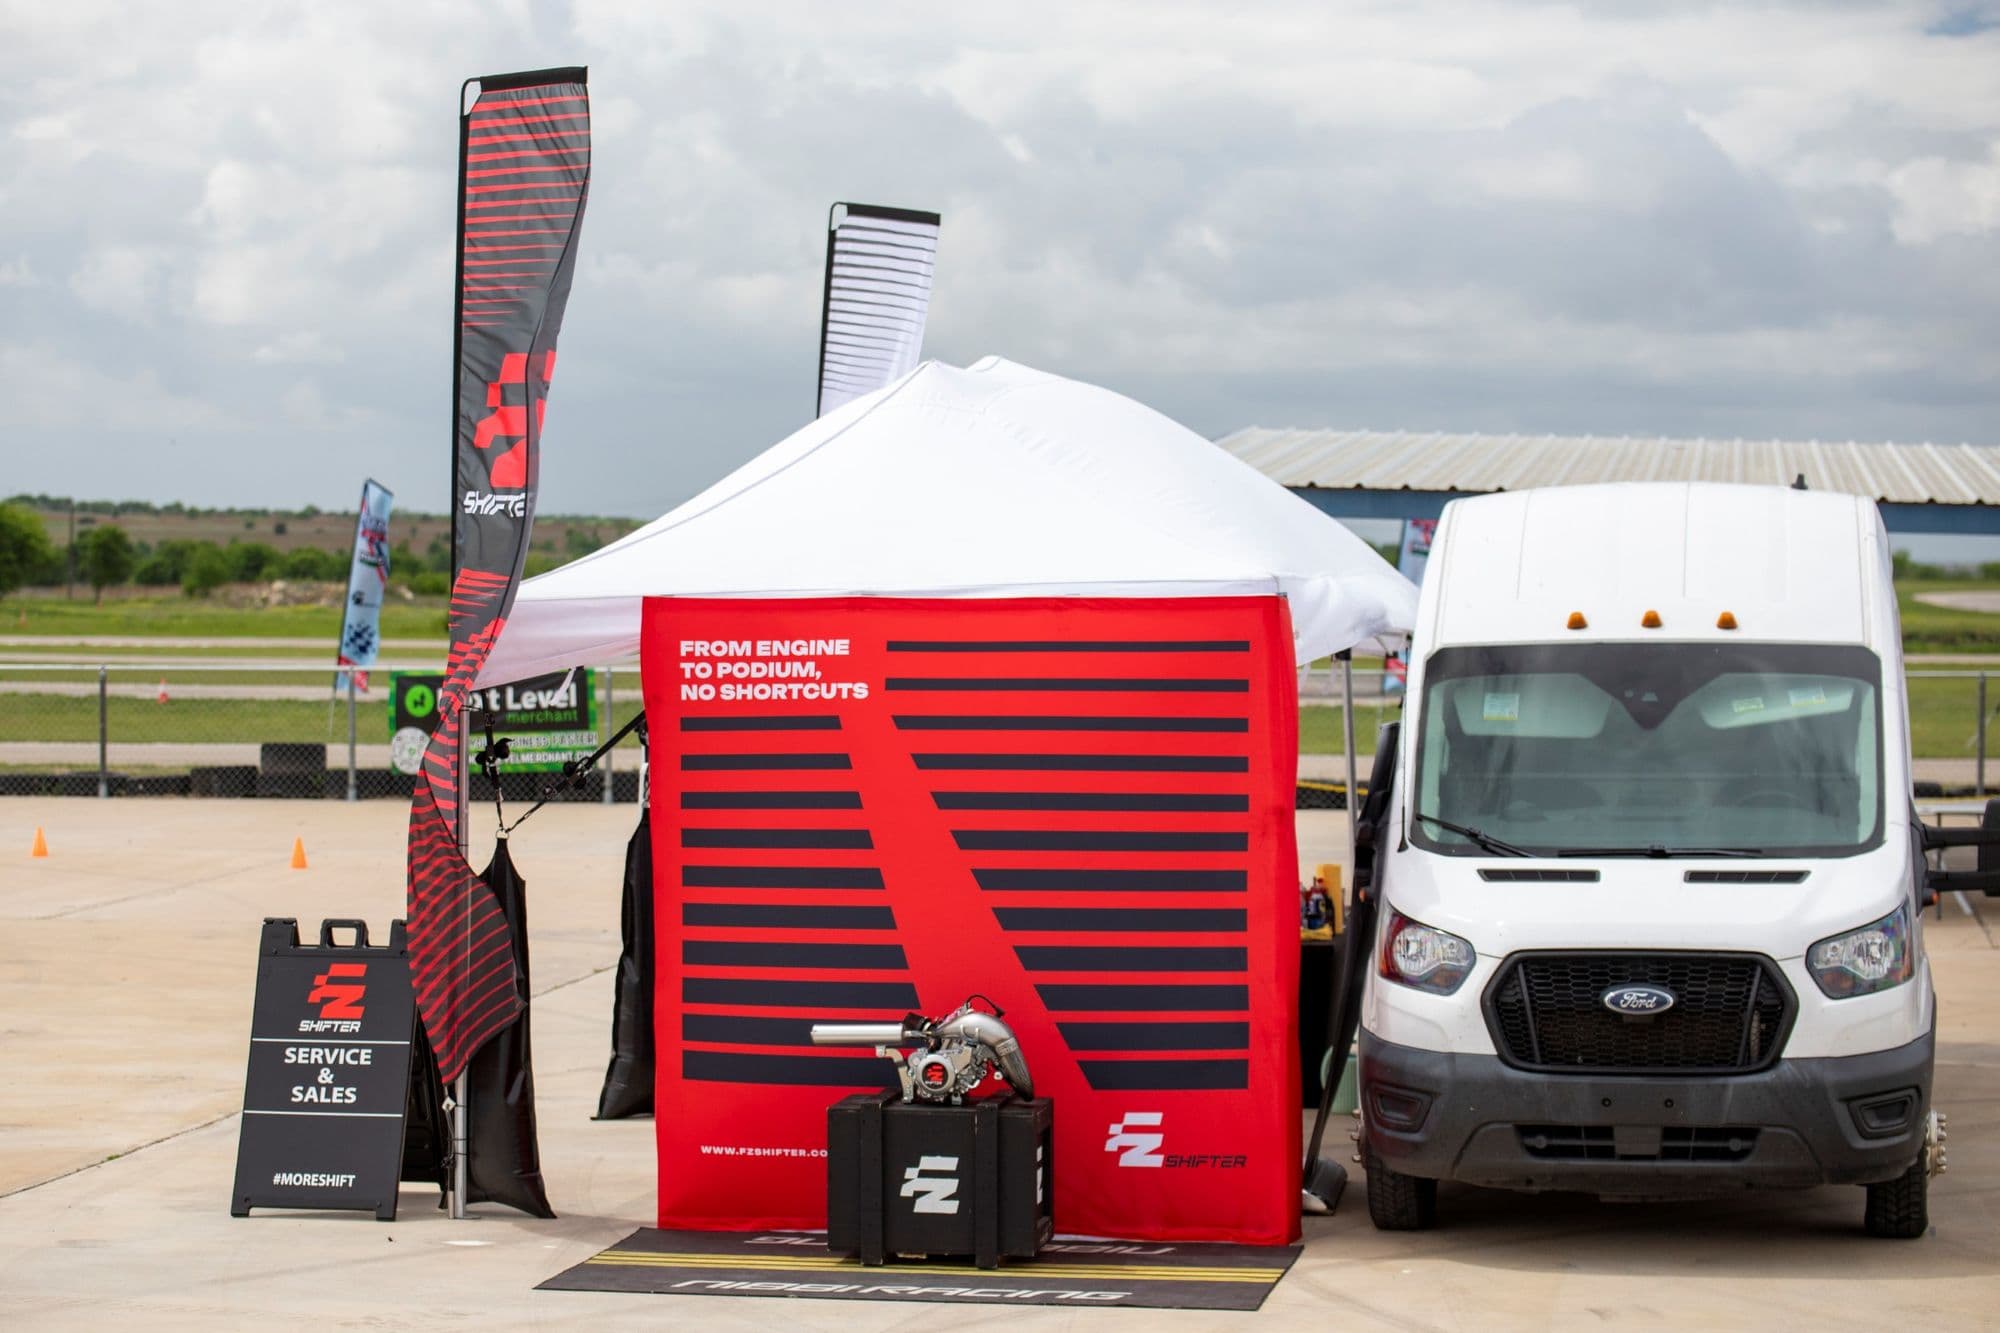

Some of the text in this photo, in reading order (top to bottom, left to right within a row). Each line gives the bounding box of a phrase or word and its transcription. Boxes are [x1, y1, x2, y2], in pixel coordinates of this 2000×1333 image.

[679, 639, 850, 657] FROM ENGINE
[679, 661, 822, 680] TO PODIUM,
[680, 682, 870, 701] NO SHORTCUTS
[505, 710, 578, 724] merchant
[1620, 992, 1658, 1009] Ford
[298, 1020, 361, 1033] SHIFTER
[284, 1047, 372, 1065] SERVICE
[317, 1067, 335, 1084] &
[290, 1085, 358, 1104] SALES
[700, 1145, 829, 1158] WWW.FZSHIFTER.CO
[1165, 1154, 1248, 1169] SHIFTER
[273, 1172, 356, 1188] #MORESHIFT
[856, 1285, 1133, 1301] RACING
